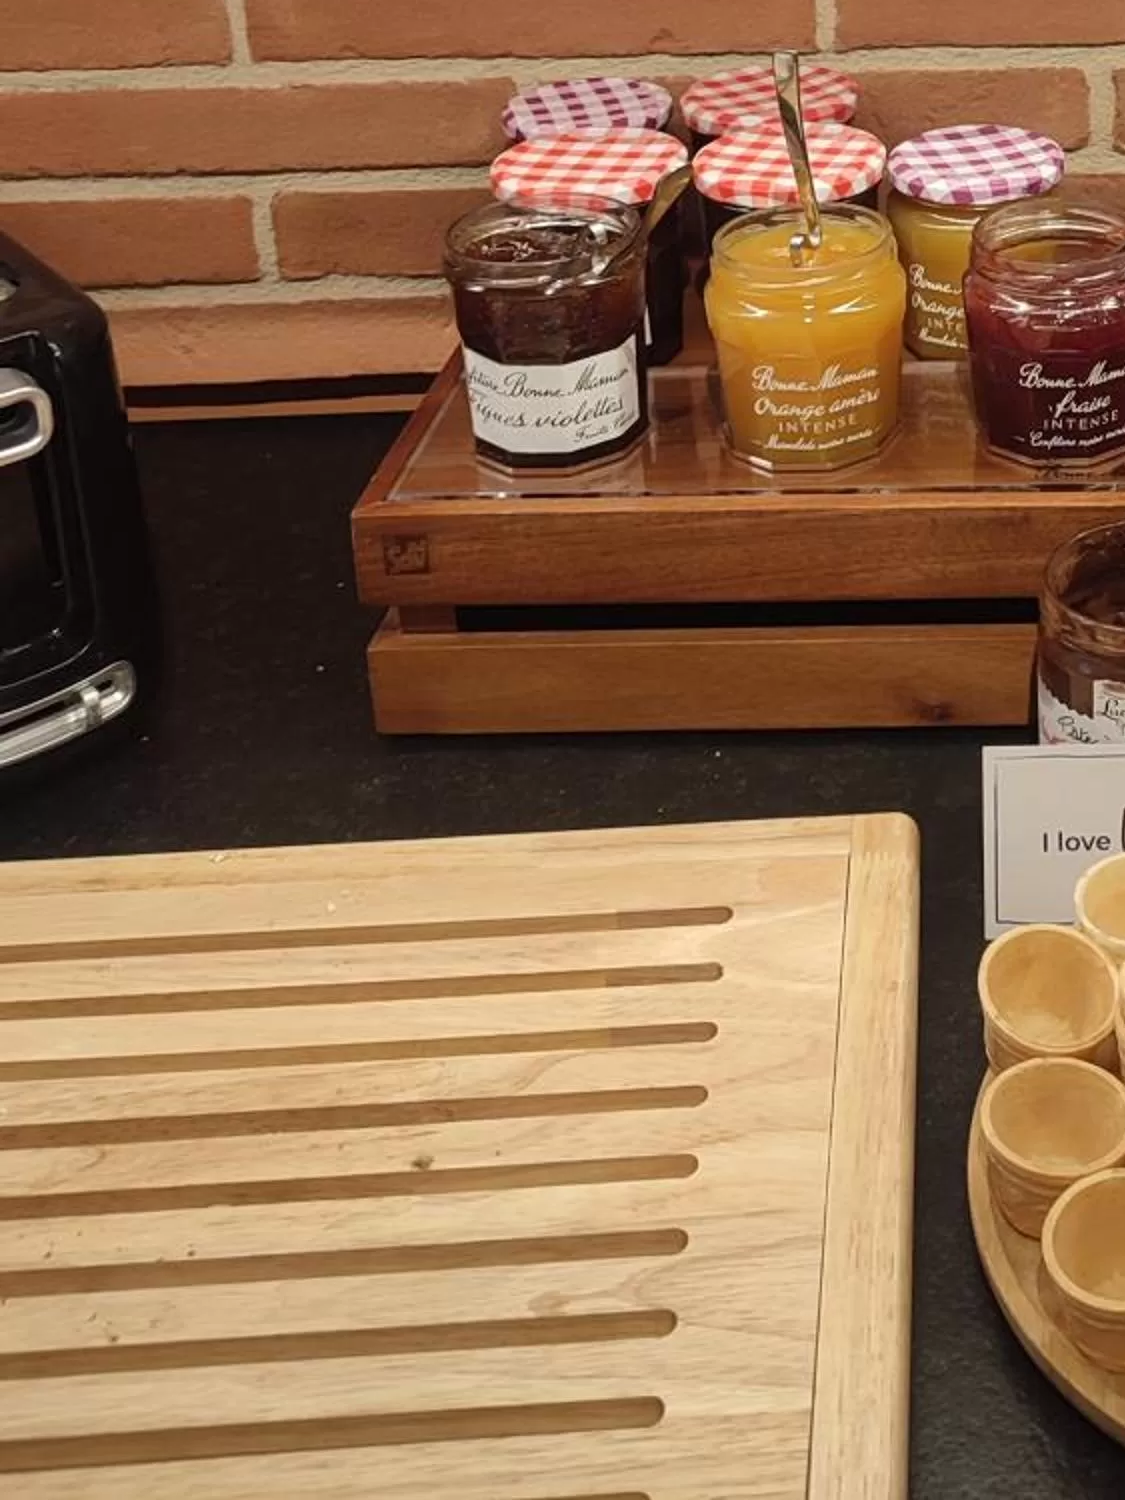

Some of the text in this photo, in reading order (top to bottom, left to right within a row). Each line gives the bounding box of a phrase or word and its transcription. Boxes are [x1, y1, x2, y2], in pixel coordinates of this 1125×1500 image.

[927, 317, 963, 334] INTE
[501, 371, 565, 398] Bonne
[752, 363, 879, 391] Bonne Maman
[1018, 361, 1076, 389] Bonne
[753, 396, 825, 421] Orange
[1043, 408, 1119, 431] INTENSE
[778, 414, 858, 434] INTENSE
[1043, 832, 1048, 852] I
[1058, 831, 1111, 851] love
